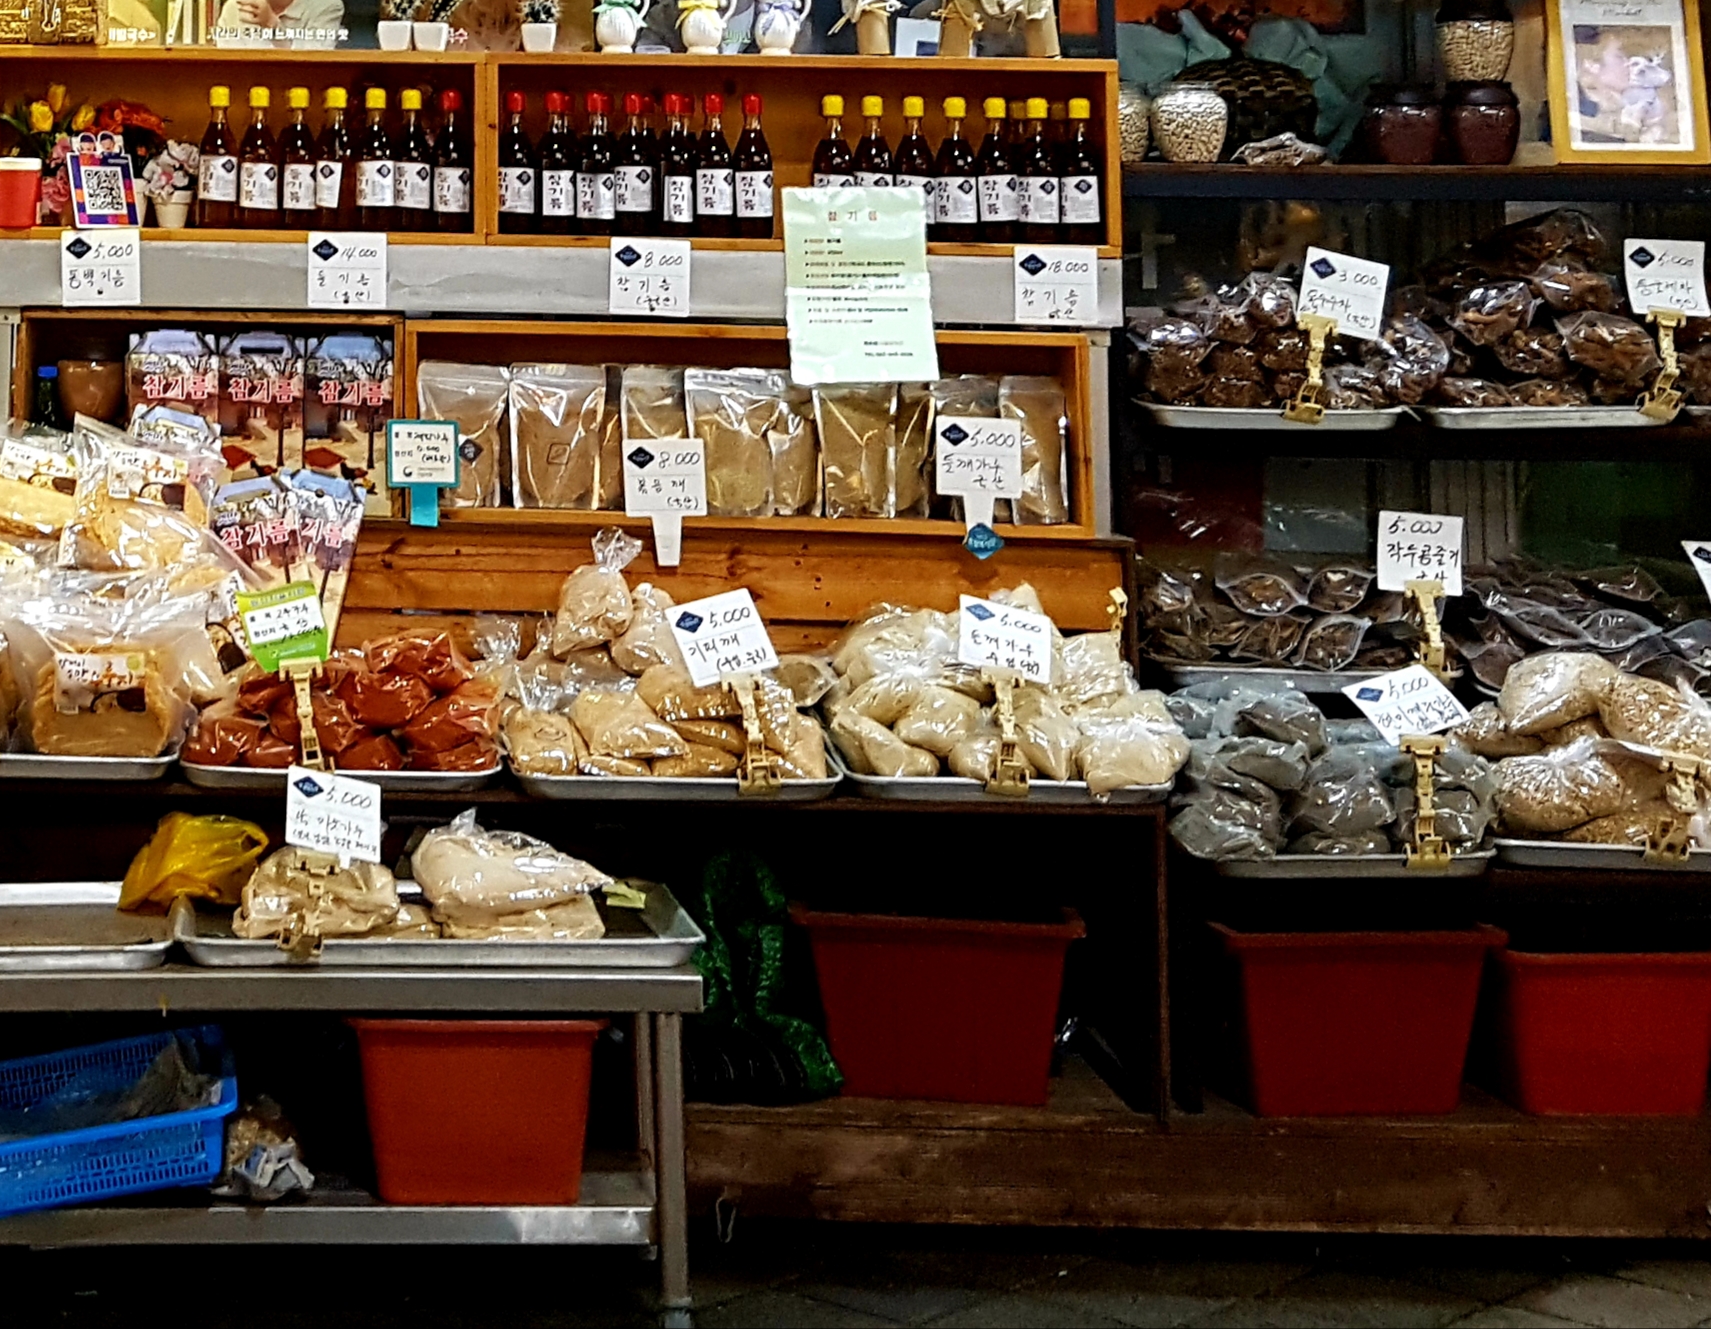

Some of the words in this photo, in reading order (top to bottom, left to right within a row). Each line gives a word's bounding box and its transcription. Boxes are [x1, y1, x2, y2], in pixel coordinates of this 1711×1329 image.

[142, 373, 211, 401] 참기름
[228, 375, 296, 404] 참기름
[319, 379, 386, 408] 참기름
[220, 517, 290, 551] 참기름
